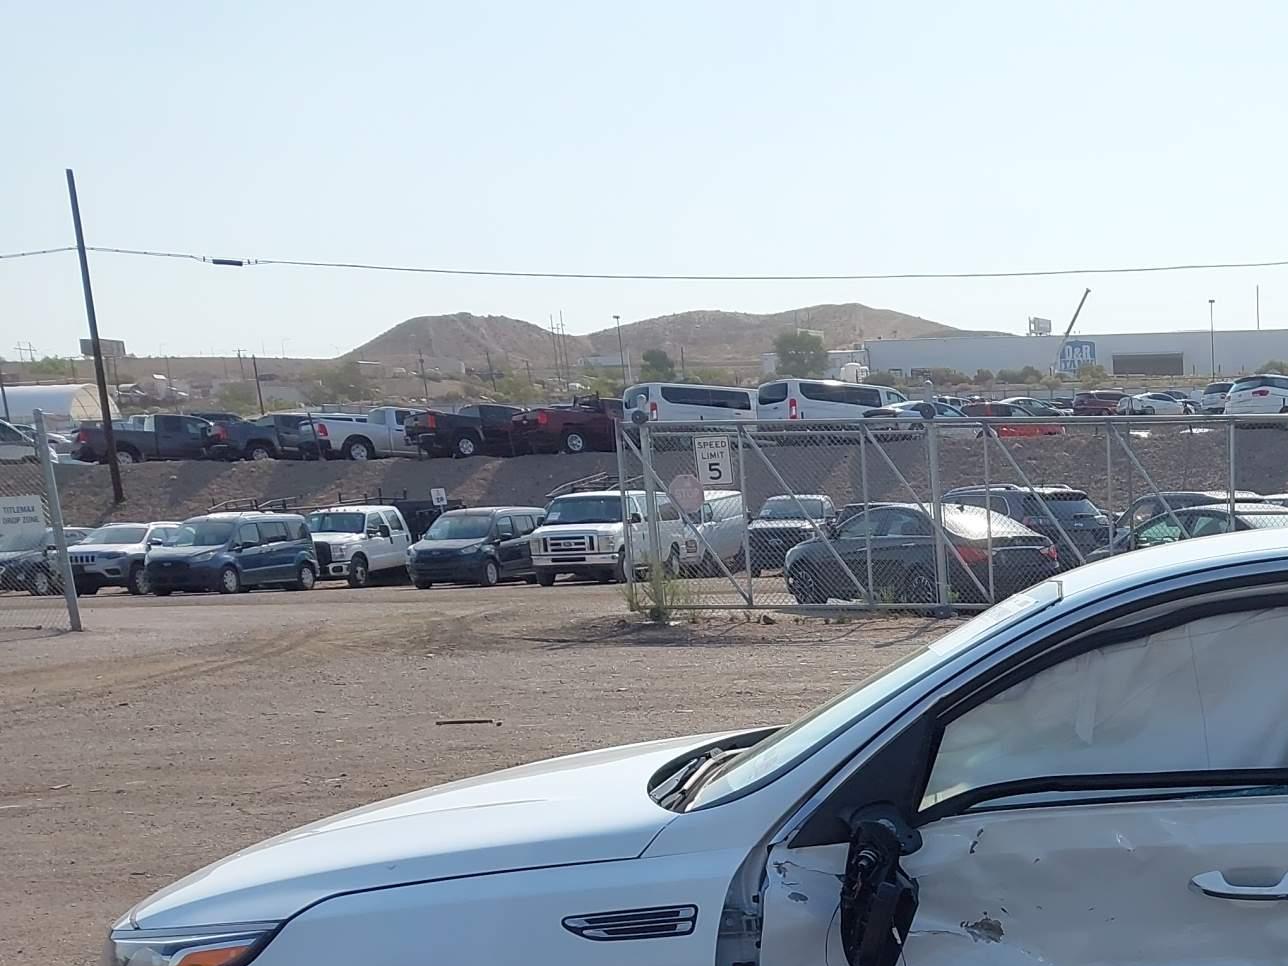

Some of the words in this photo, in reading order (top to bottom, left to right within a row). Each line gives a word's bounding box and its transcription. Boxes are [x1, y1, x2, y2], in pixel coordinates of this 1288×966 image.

[1065, 344, 1091, 360] D&R
[697, 441, 727, 449] SPEED
[701, 451, 725, 460] LIMIT
[708, 462, 723, 480] 5
